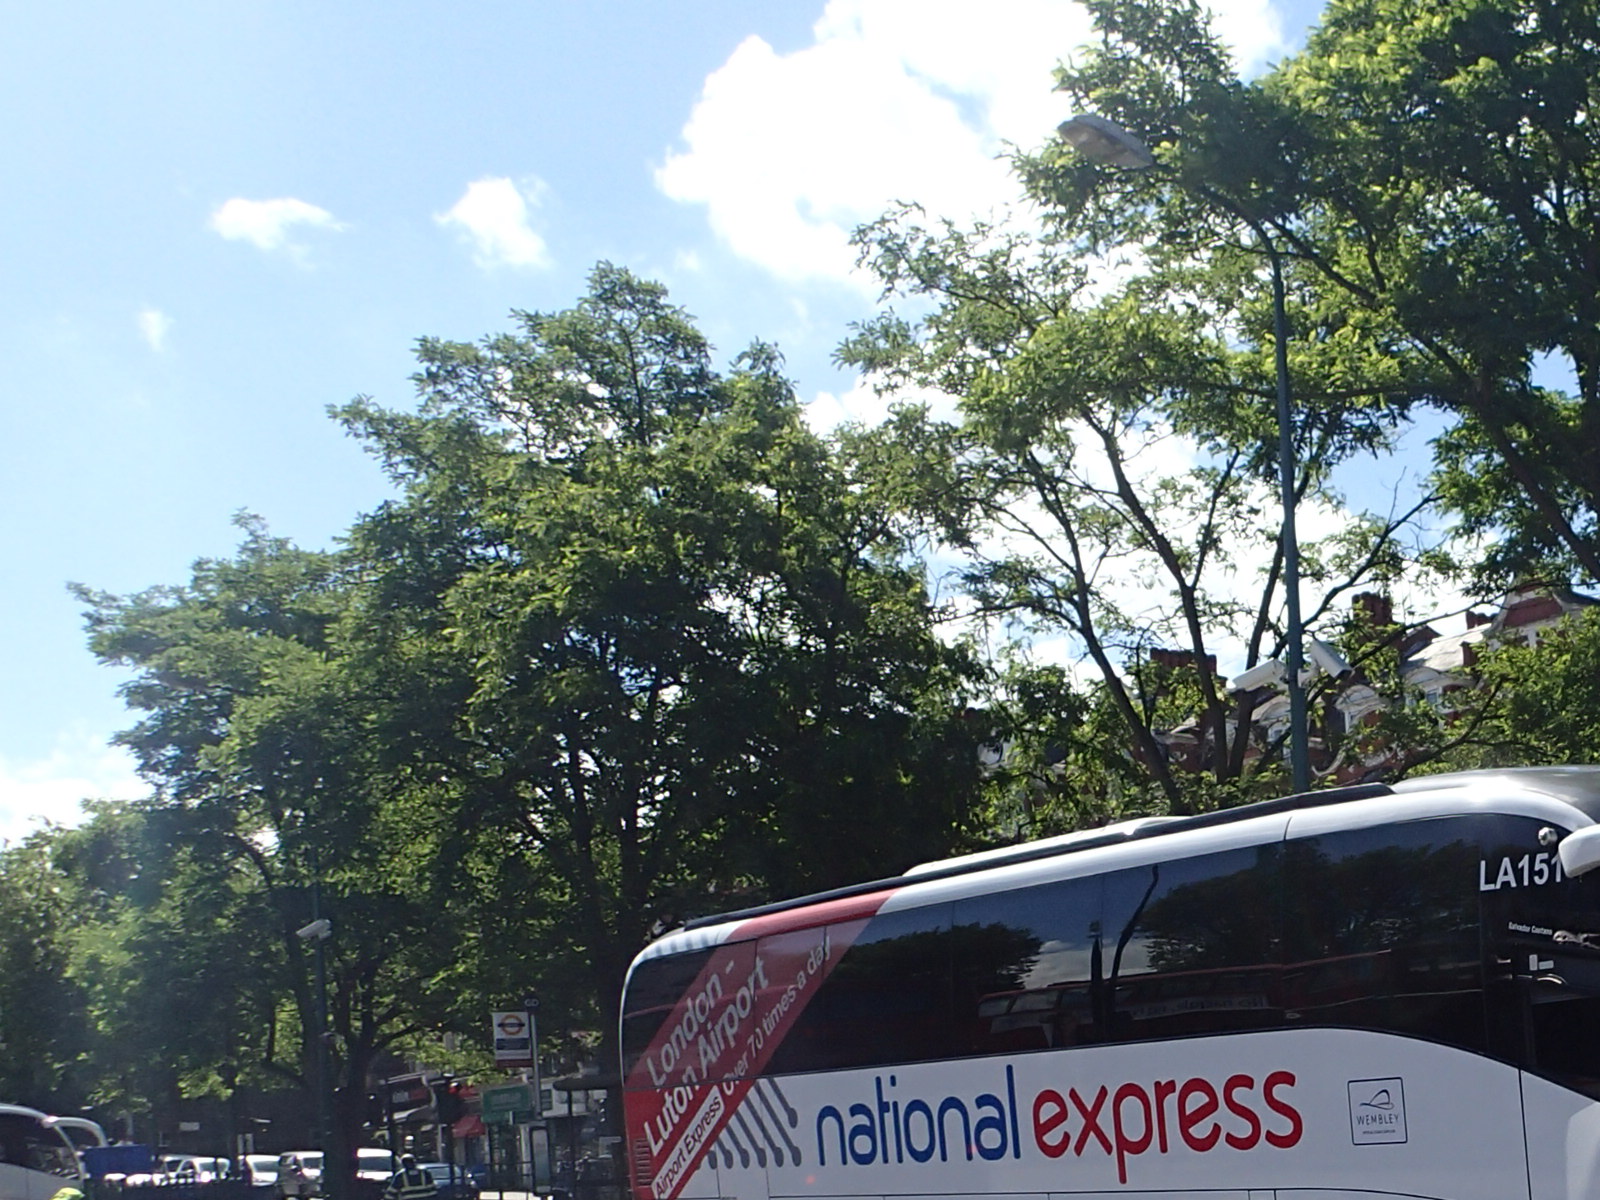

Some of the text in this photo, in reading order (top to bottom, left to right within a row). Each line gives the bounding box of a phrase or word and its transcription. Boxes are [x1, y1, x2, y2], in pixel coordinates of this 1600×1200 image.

[644, 956, 769, 1156] Luton Airport
[646, 973, 723, 1090] London
[762, 984, 796, 1033] times
[655, 1096, 722, 1200] Airport Express
[816, 1063, 1304, 1184] national express
[1356, 1113, 1399, 1126] WEMBLEY
